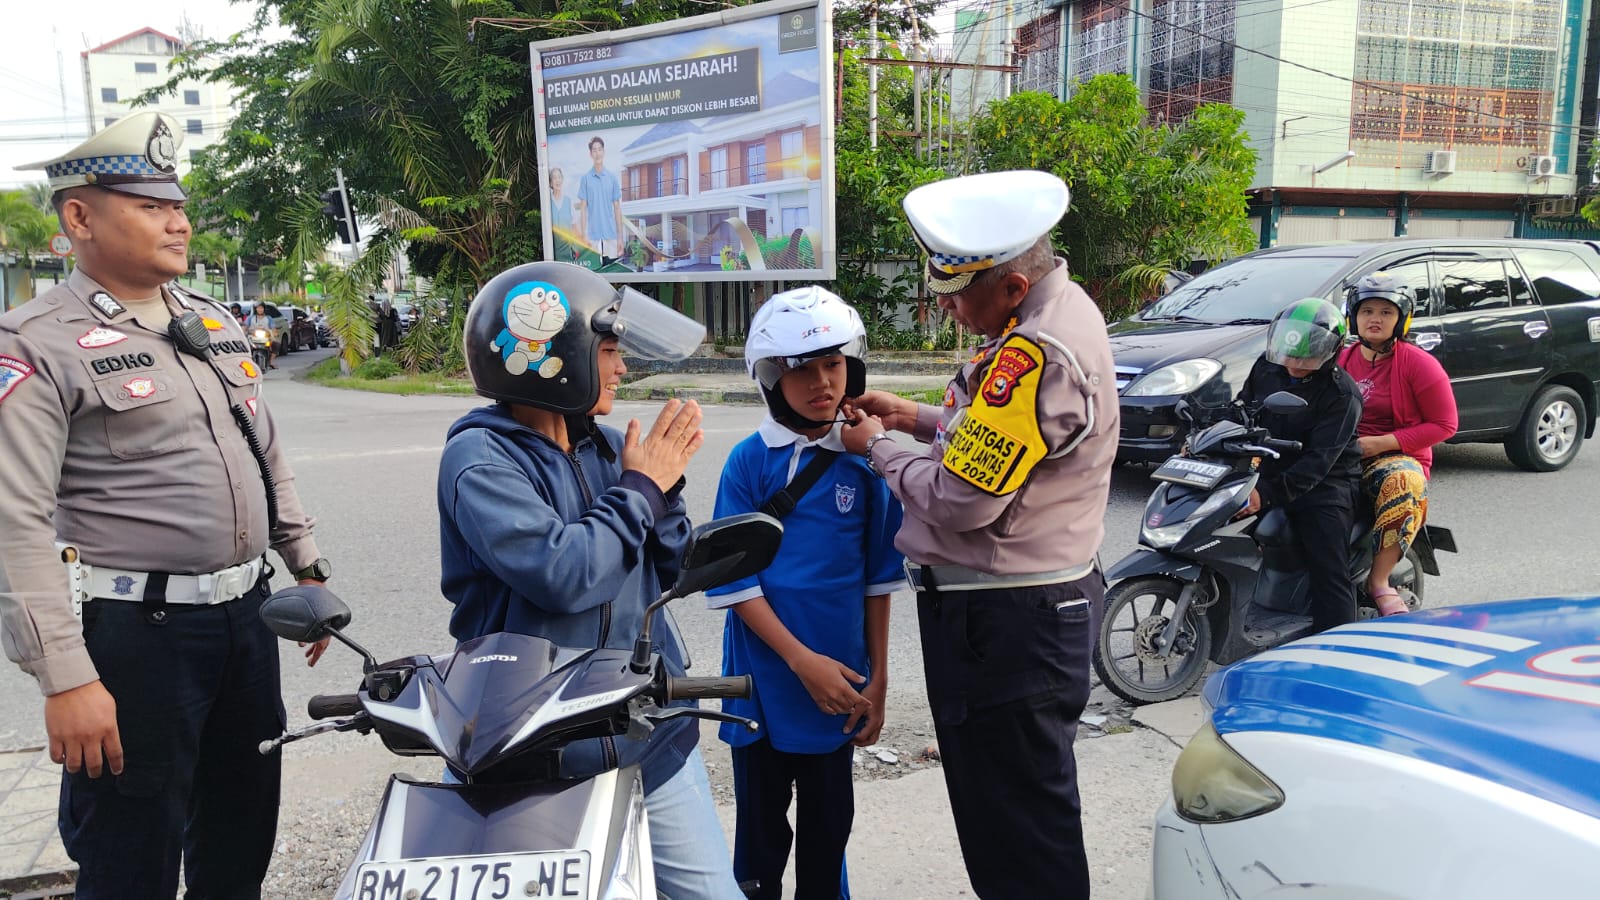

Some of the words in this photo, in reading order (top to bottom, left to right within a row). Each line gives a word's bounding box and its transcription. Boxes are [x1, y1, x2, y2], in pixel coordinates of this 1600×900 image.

[551, 54, 571, 66] 0811
[574, 50, 594, 62] 7522
[596, 47, 612, 59] 882
[547, 76, 607, 99] PERTAMA
[611, 67, 661, 90] DALAM
[665, 55, 738, 82] SEJARAH!
[548, 105, 562, 116] BELI
[563, 102, 590, 114] RUMAH
[590, 97, 622, 111] DISKON
[623, 93, 653, 106] SESUAI
[654, 89, 681, 101] UMUR
[549, 119, 569, 130] AJAK
[567, 115, 593, 128] NENEK
[593, 113, 616, 124] ANDA
[616, 110, 643, 122] UNTUK
[645, 106, 670, 118] DAPAT
[671, 102, 702, 115] DISKON
[704, 98, 728, 111] LEBIH
[729, 94, 759, 107] BESAR!
[91, 351, 155, 375] EDHO
[1003, 350, 1029, 368] POLDA
[970, 446, 1005, 475] LANTAS
[961, 462, 994, 486] 2024
[560, 693, 616, 713] TECHNO
[358, 869, 407, 900] BM
[420, 861, 512, 900] 2175
[537, 858, 581, 897] NE
